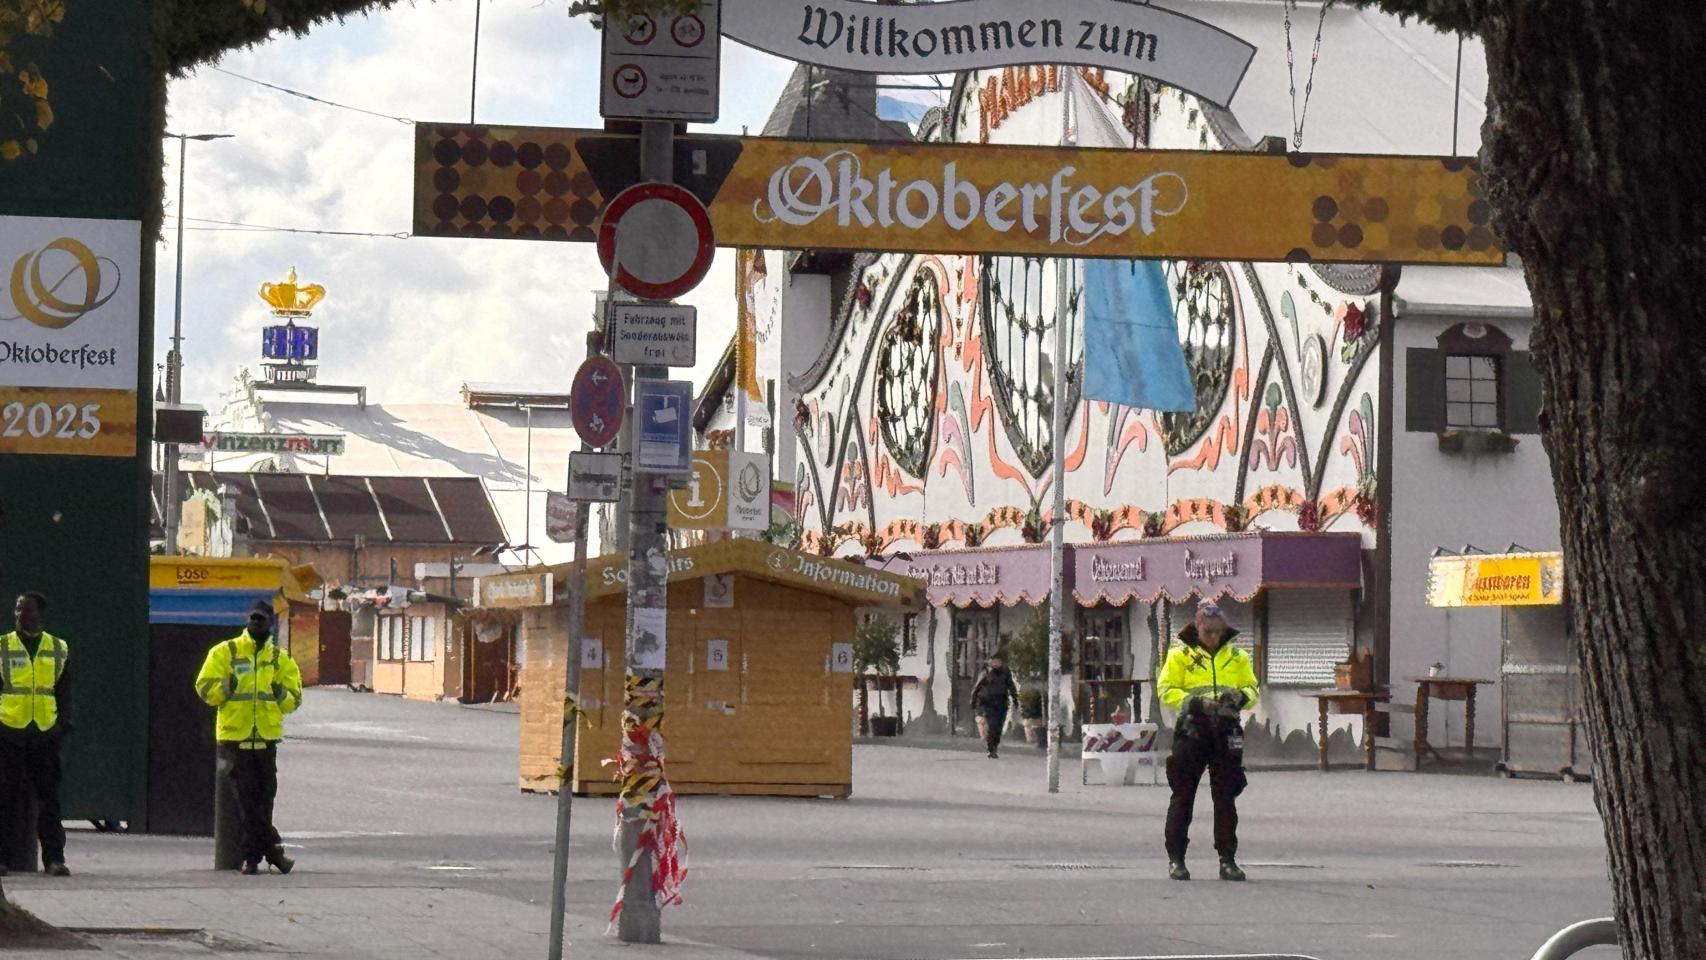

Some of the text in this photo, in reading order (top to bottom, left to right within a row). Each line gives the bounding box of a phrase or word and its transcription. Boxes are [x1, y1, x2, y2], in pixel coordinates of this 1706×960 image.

[797, 5, 1159, 62] Willkommen zum
[754, 149, 1188, 246] Oktoberfest
[670, 314, 686, 326] mit
[0, 341, 117, 370] Oktoberfest
[644, 345, 666, 358] frei
[3, 401, 101, 439] 2025
[176, 567, 209, 580] Lose
[793, 554, 900, 598] Information
[837, 650, 848, 665] 6
